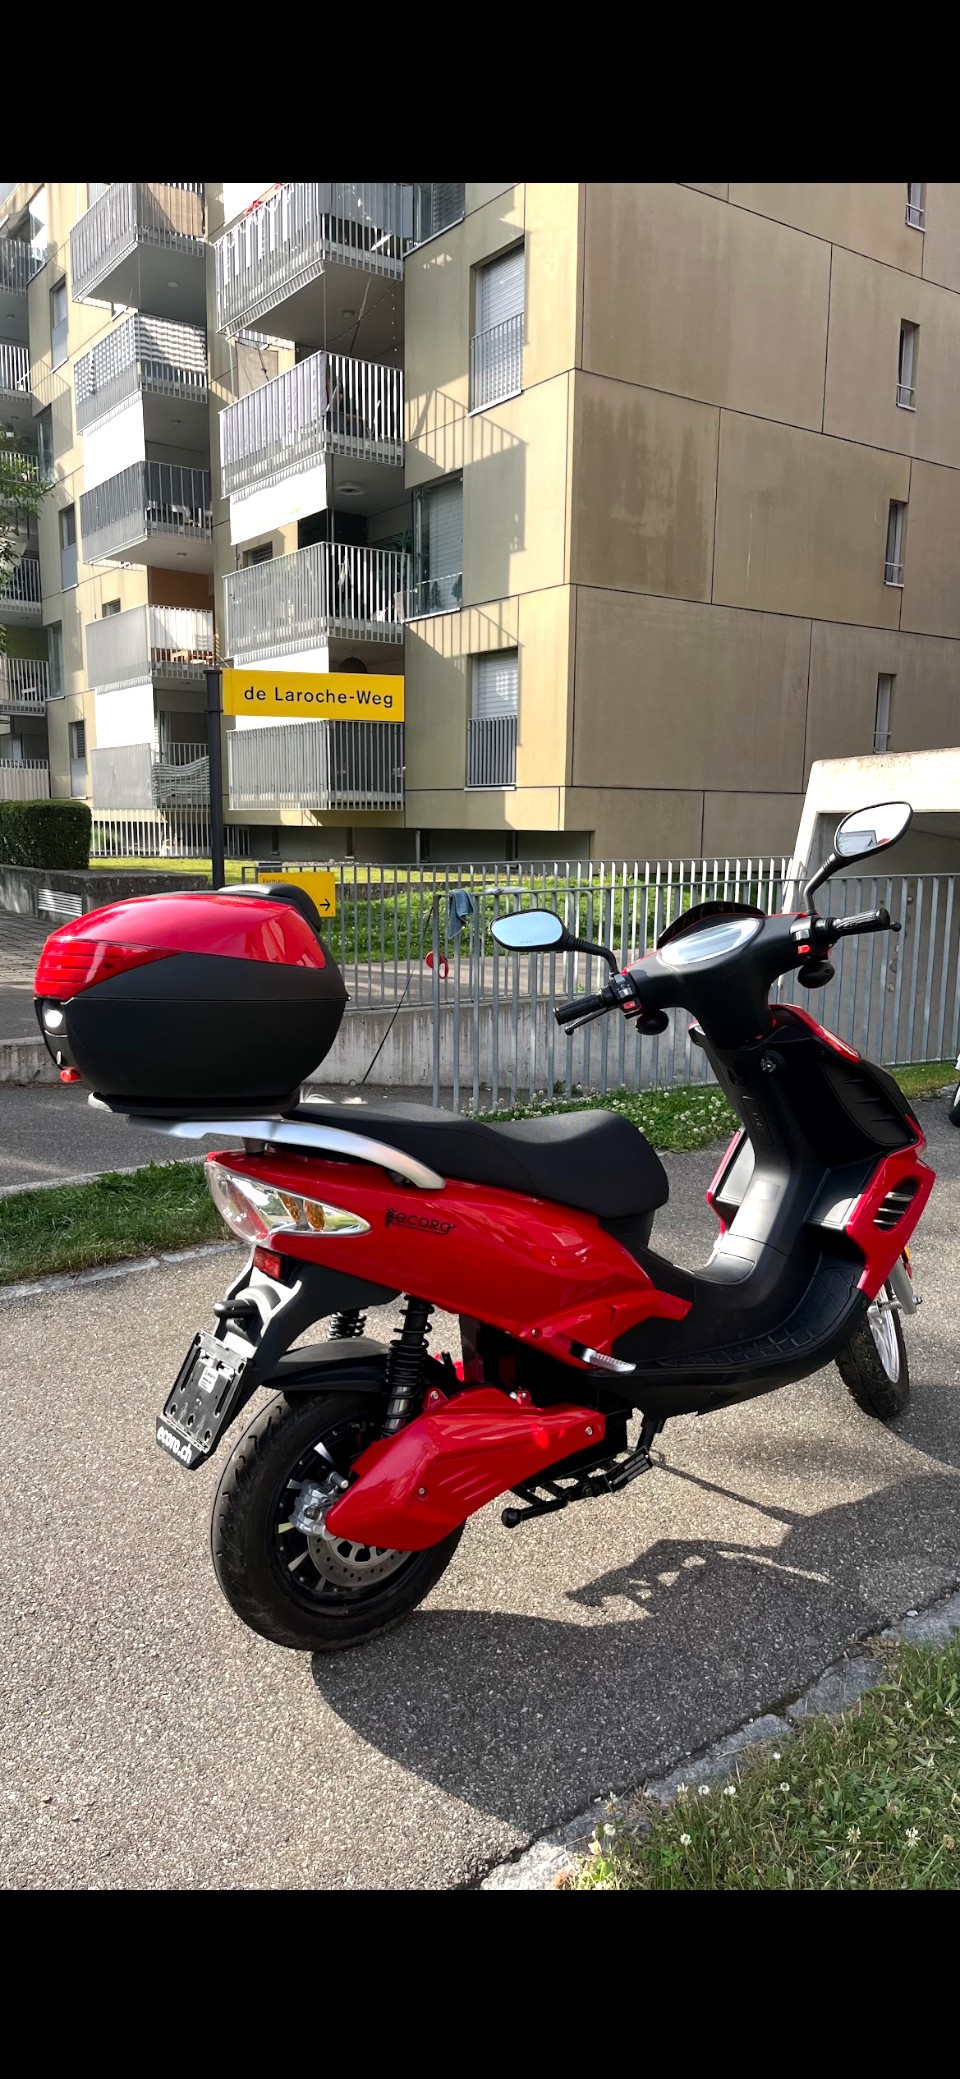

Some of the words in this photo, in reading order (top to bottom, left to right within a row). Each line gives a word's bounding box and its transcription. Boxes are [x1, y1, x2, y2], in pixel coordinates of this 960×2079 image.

[244, 686, 266, 700] de
[275, 687, 393, 708] Laroche-Weg
[157, 1426, 192, 1463] ecoro.ch
